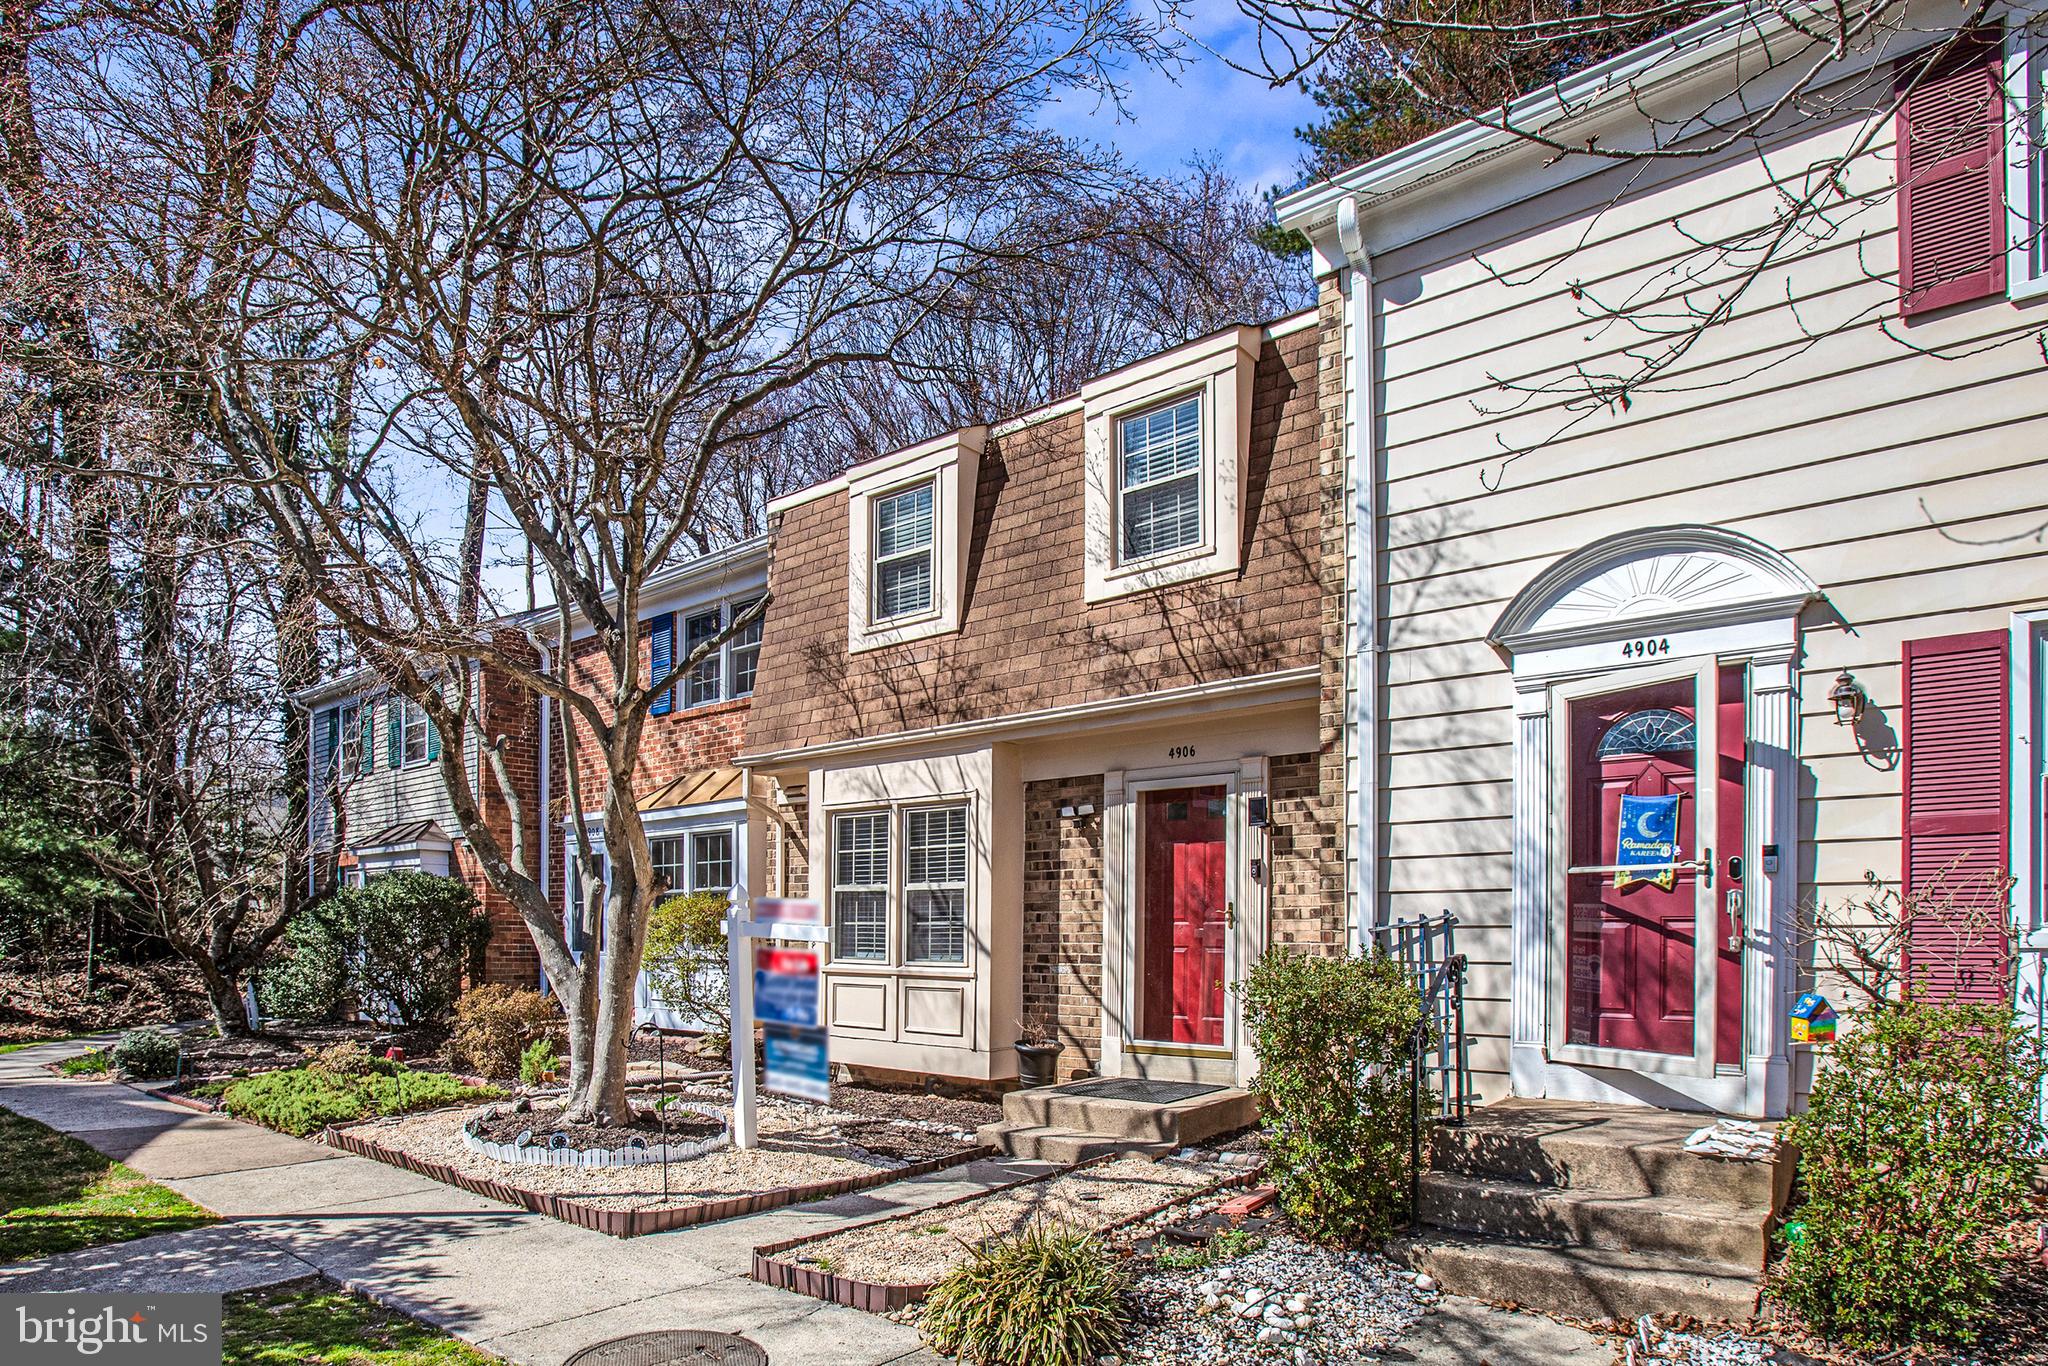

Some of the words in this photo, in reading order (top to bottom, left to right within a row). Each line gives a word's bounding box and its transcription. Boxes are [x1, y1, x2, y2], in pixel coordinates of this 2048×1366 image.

[1622, 638, 1670, 658] 4904
[1168, 745, 1196, 759] 4906
[587, 827, 600, 837] 908
